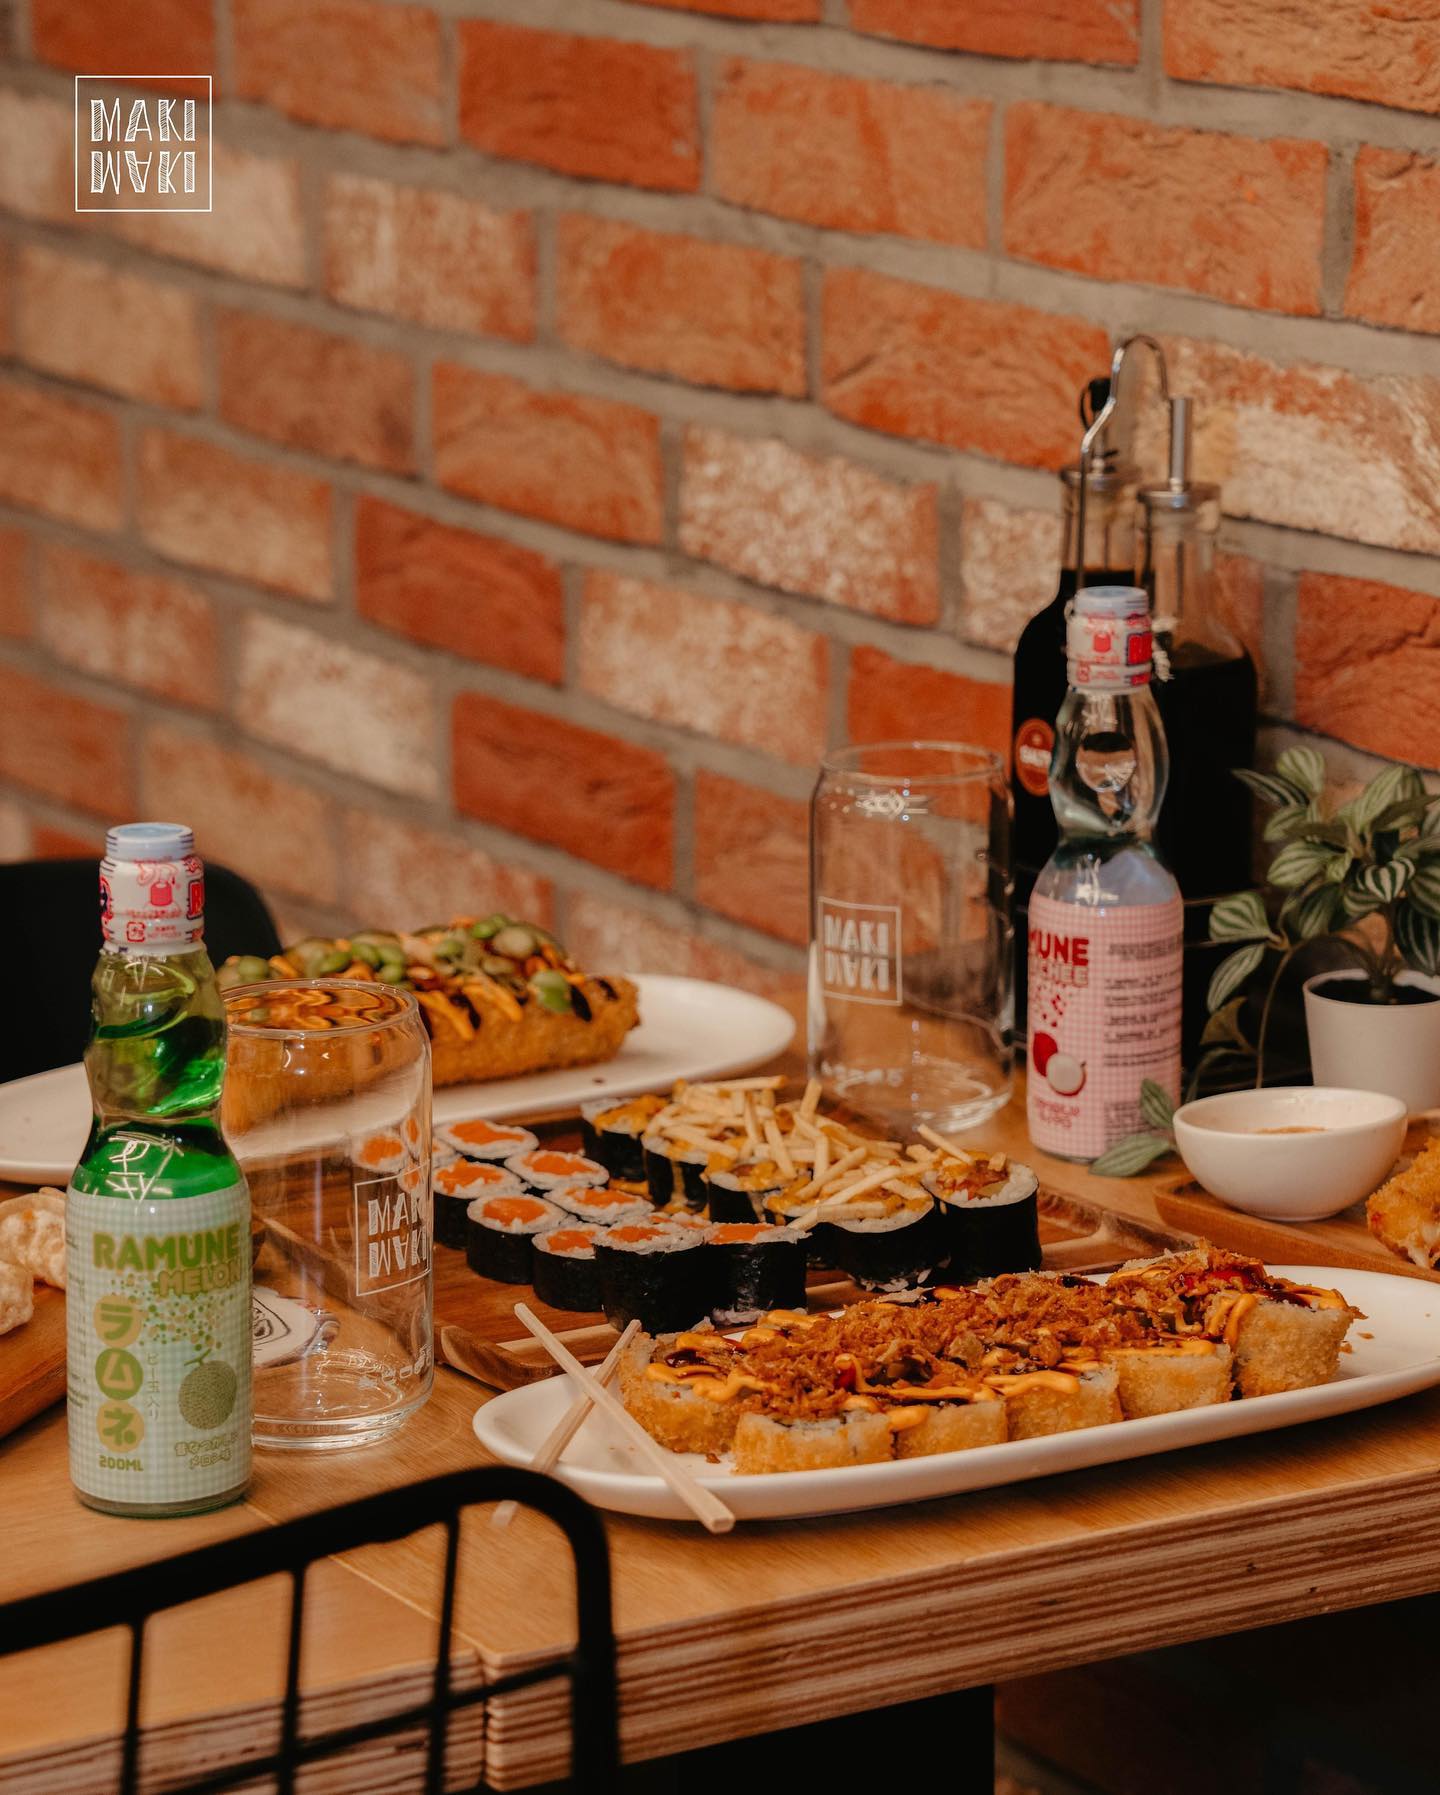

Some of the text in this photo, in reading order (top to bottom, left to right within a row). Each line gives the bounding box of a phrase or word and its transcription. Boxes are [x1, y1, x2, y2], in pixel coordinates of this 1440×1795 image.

[824, 914, 889, 957] MAKI
[93, 1222, 241, 1272] RAMUNE
[158, 1258, 241, 1299] MELON
[98, 1300, 140, 1450] ラムネ
[99, 1455, 144, 1472] 200ML
